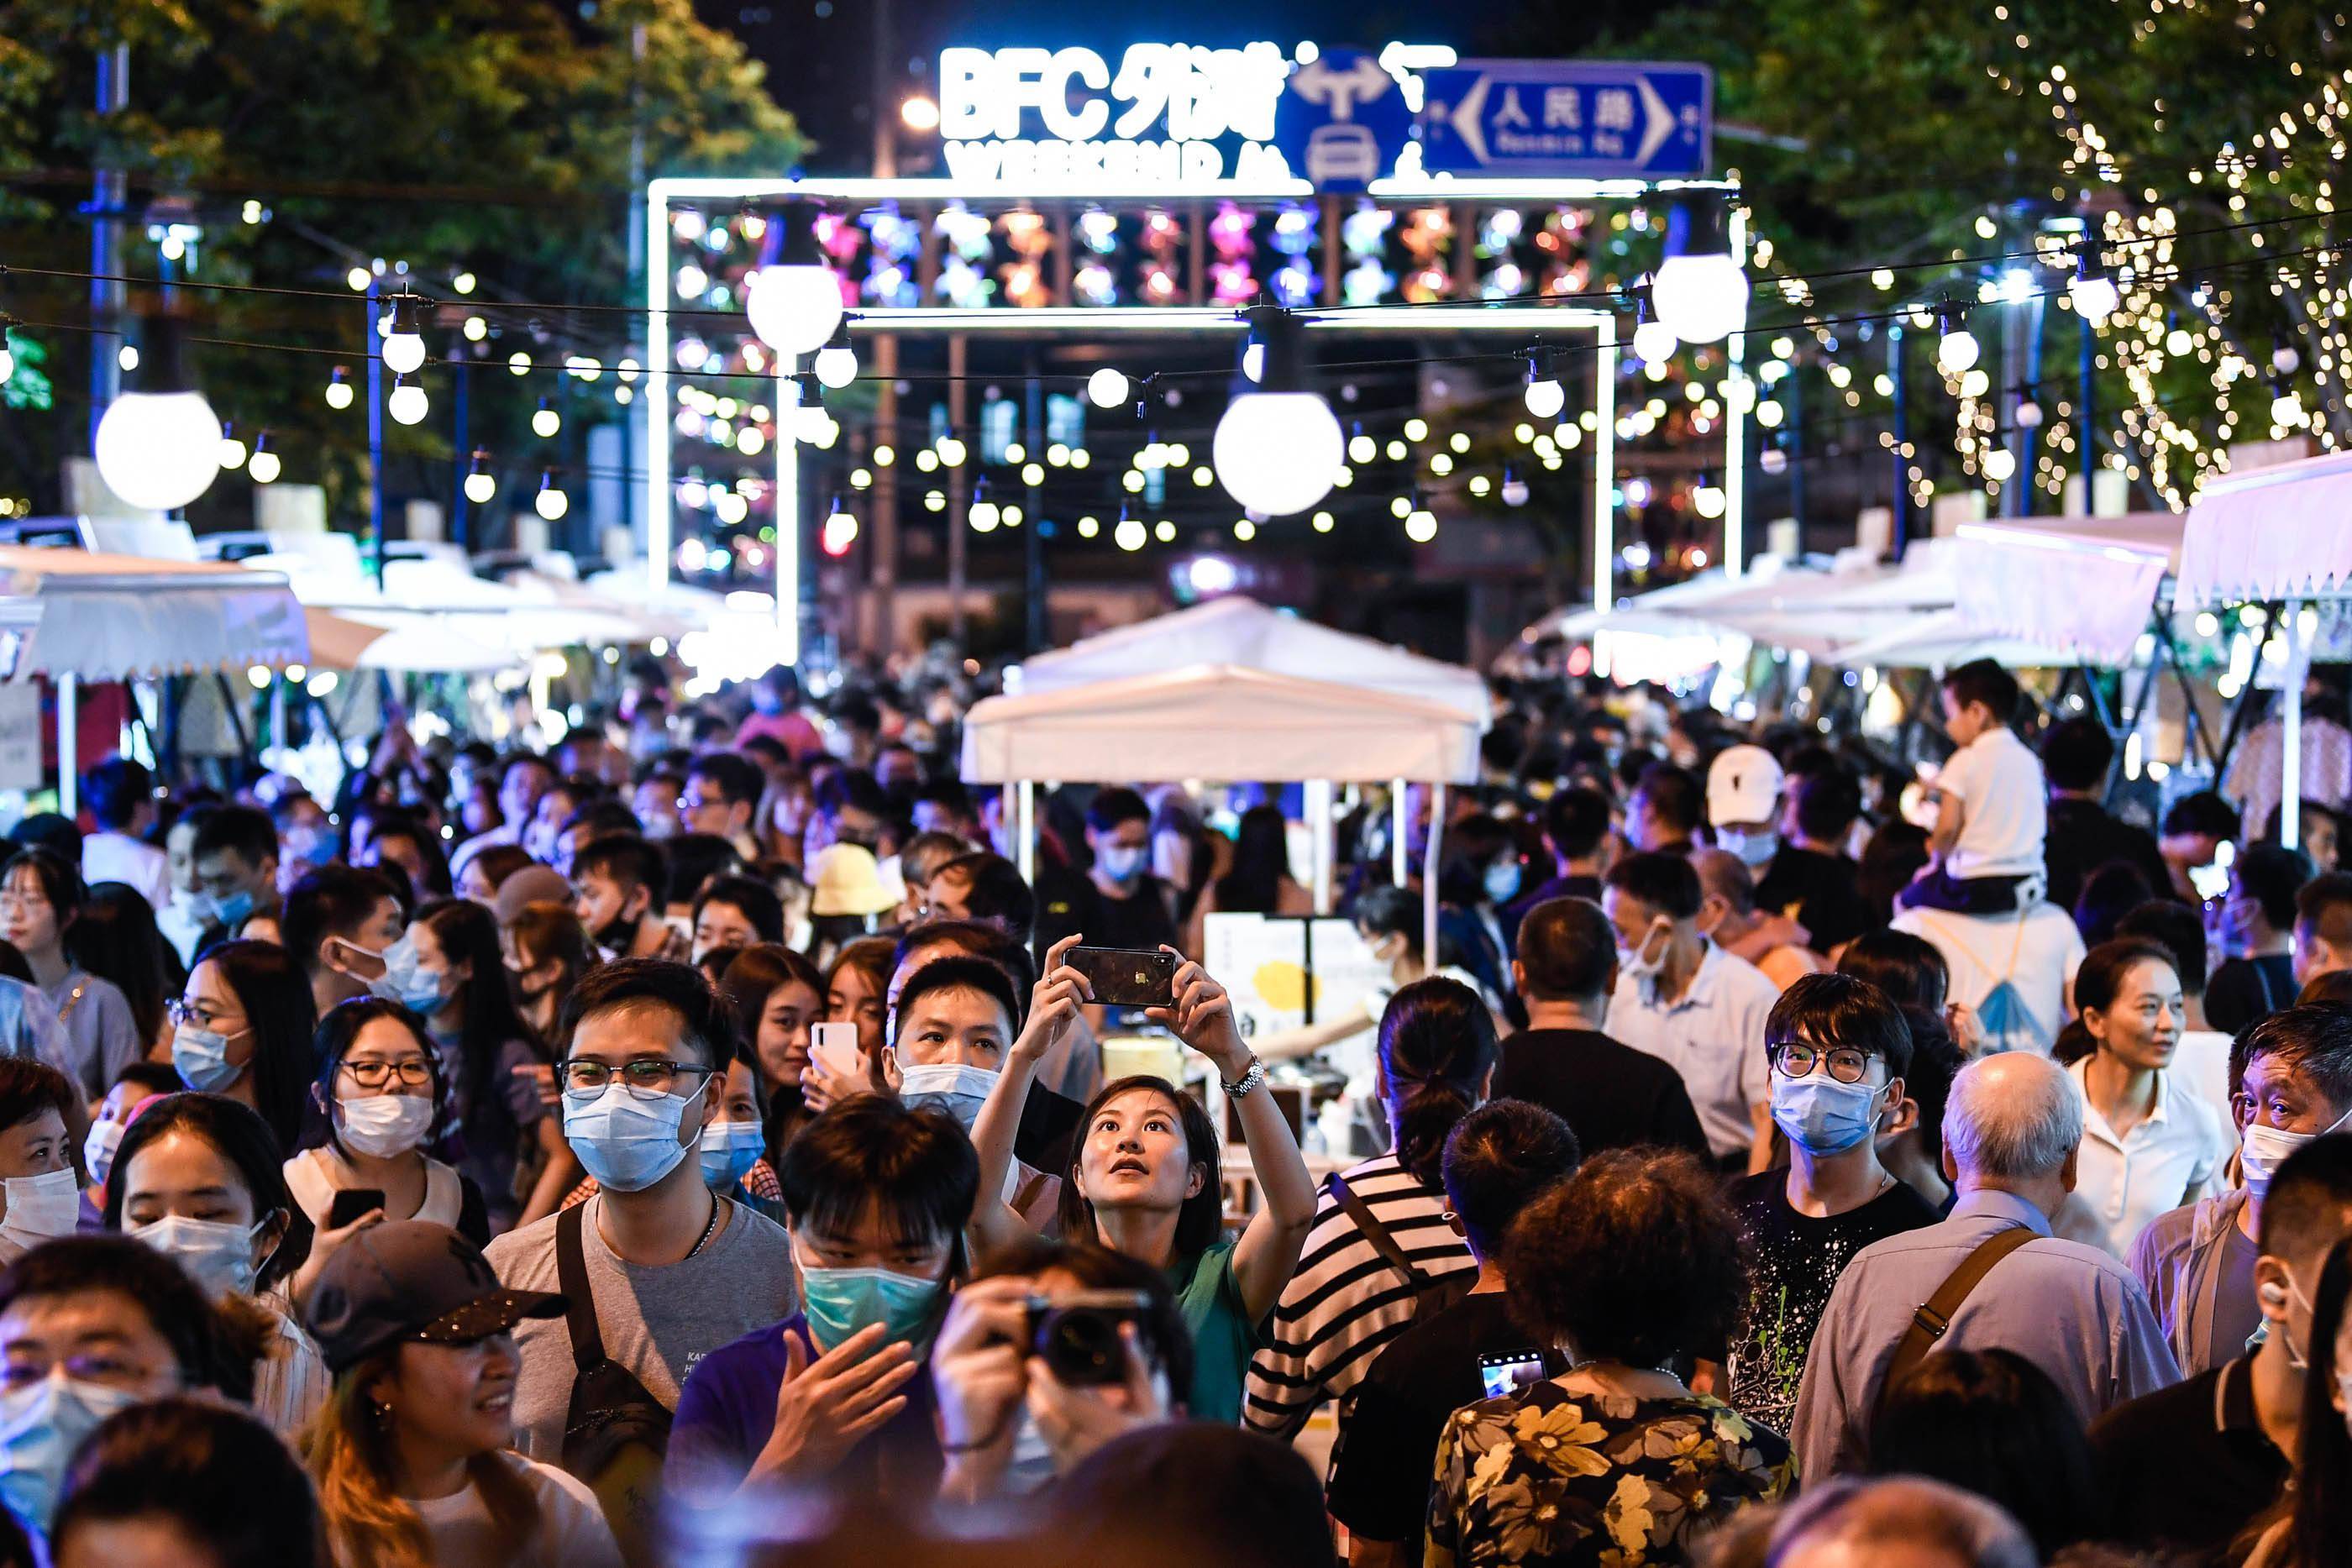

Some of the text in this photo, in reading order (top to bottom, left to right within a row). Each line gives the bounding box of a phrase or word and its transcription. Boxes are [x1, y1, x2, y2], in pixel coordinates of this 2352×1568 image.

[939, 46, 1110, 141] BFC
[1492, 87, 1635, 131] 人民路
[943, 140, 1224, 180] WEEKEND
